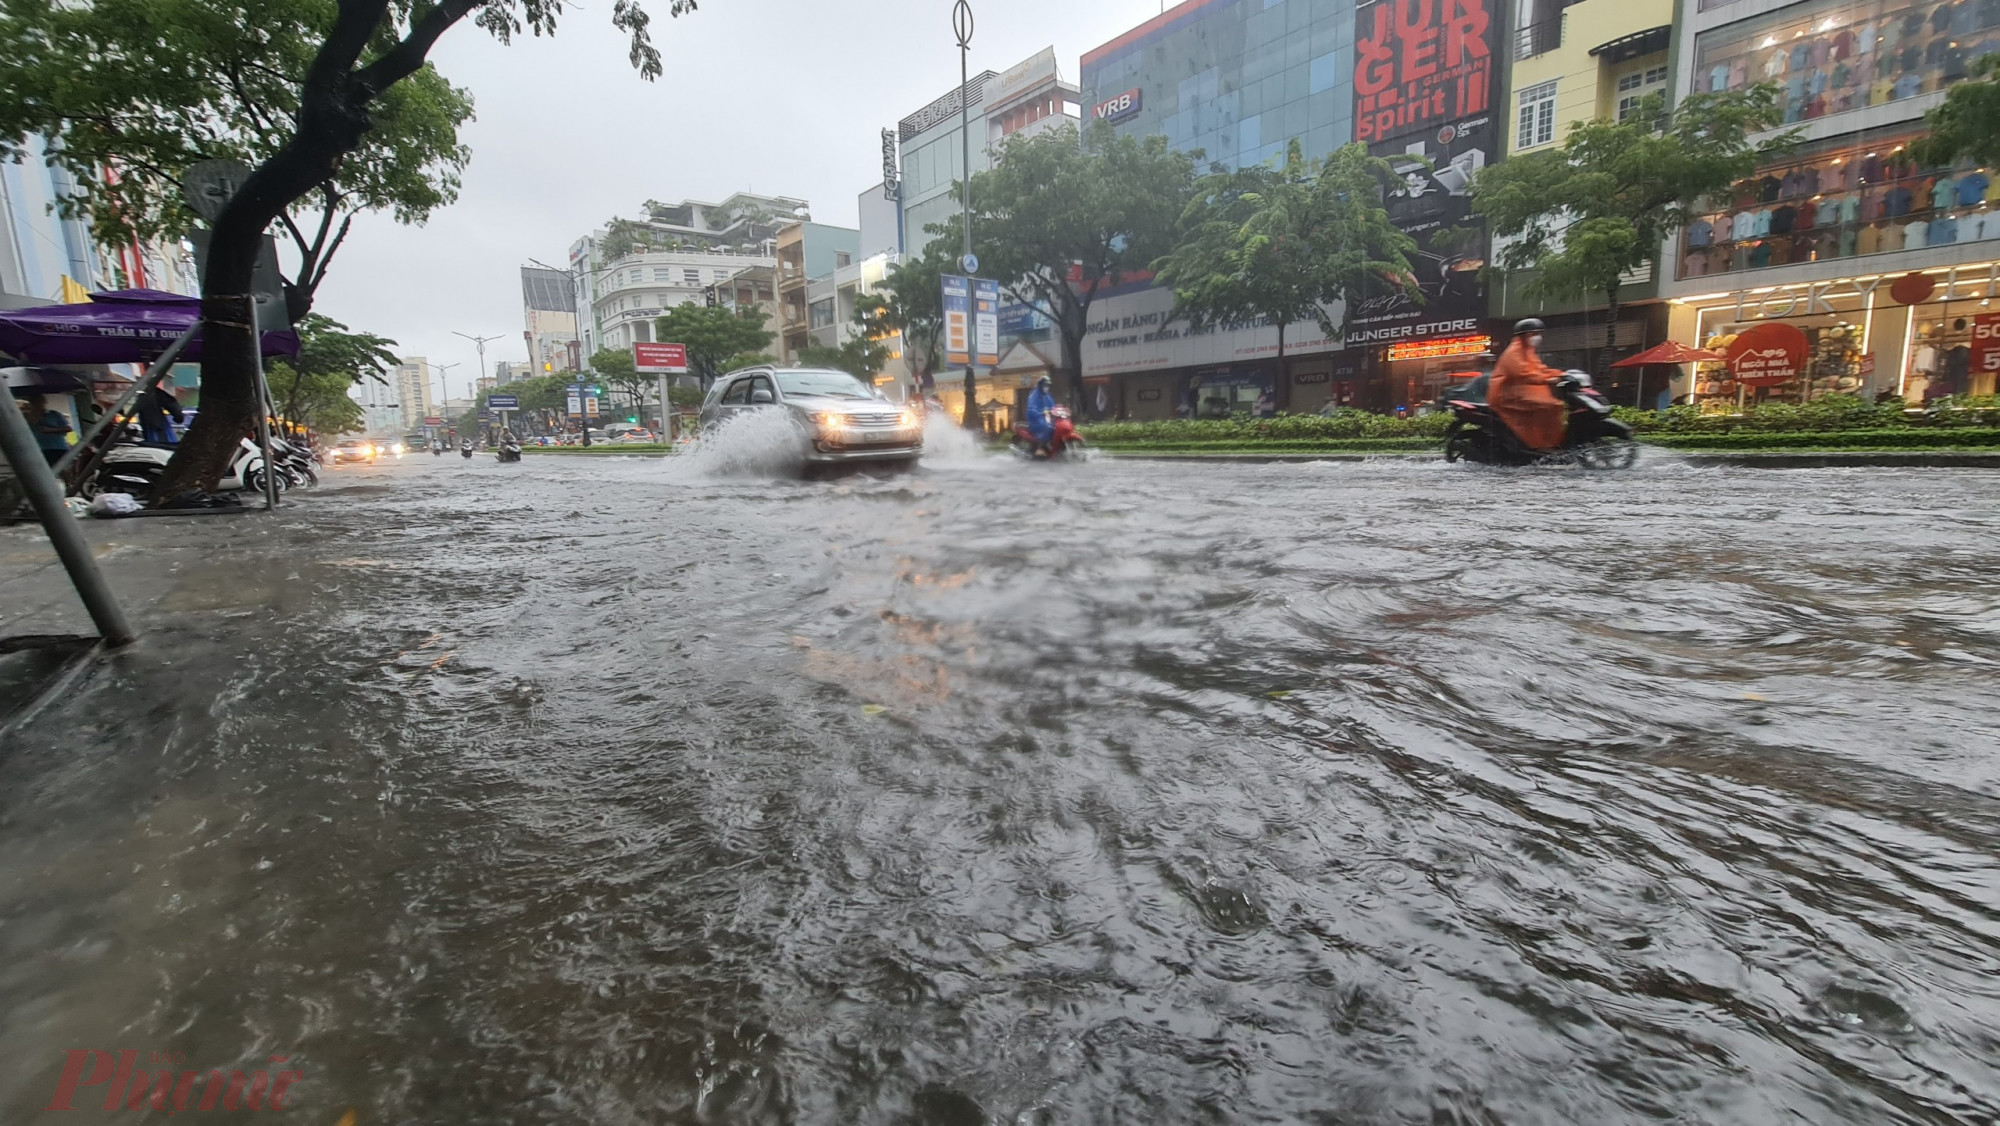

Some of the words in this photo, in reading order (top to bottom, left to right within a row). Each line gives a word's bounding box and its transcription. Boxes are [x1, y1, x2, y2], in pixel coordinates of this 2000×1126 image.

[1423, 60, 1484, 86] GERMAN
[1096, 94, 1131, 119] VRB
[1357, 88, 1446, 141] spirit
[1457, 117, 1489, 131] German
[882, 127, 899, 201] FORMAT
[1087, 317, 1119, 335] NGÂN
[1122, 313, 1158, 330] HÀNG
[1097, 335, 1138, 349] VIETNAM
[1220, 315, 1275, 332] VENTUR
[1346, 325, 1413, 343] JÜNGER
[1415, 318, 1477, 335] STORE
[1335, 366, 1353, 376] ATM
[1767, 357, 1790, 367] NHÀ
[1299, 374, 1325, 383] VRB
